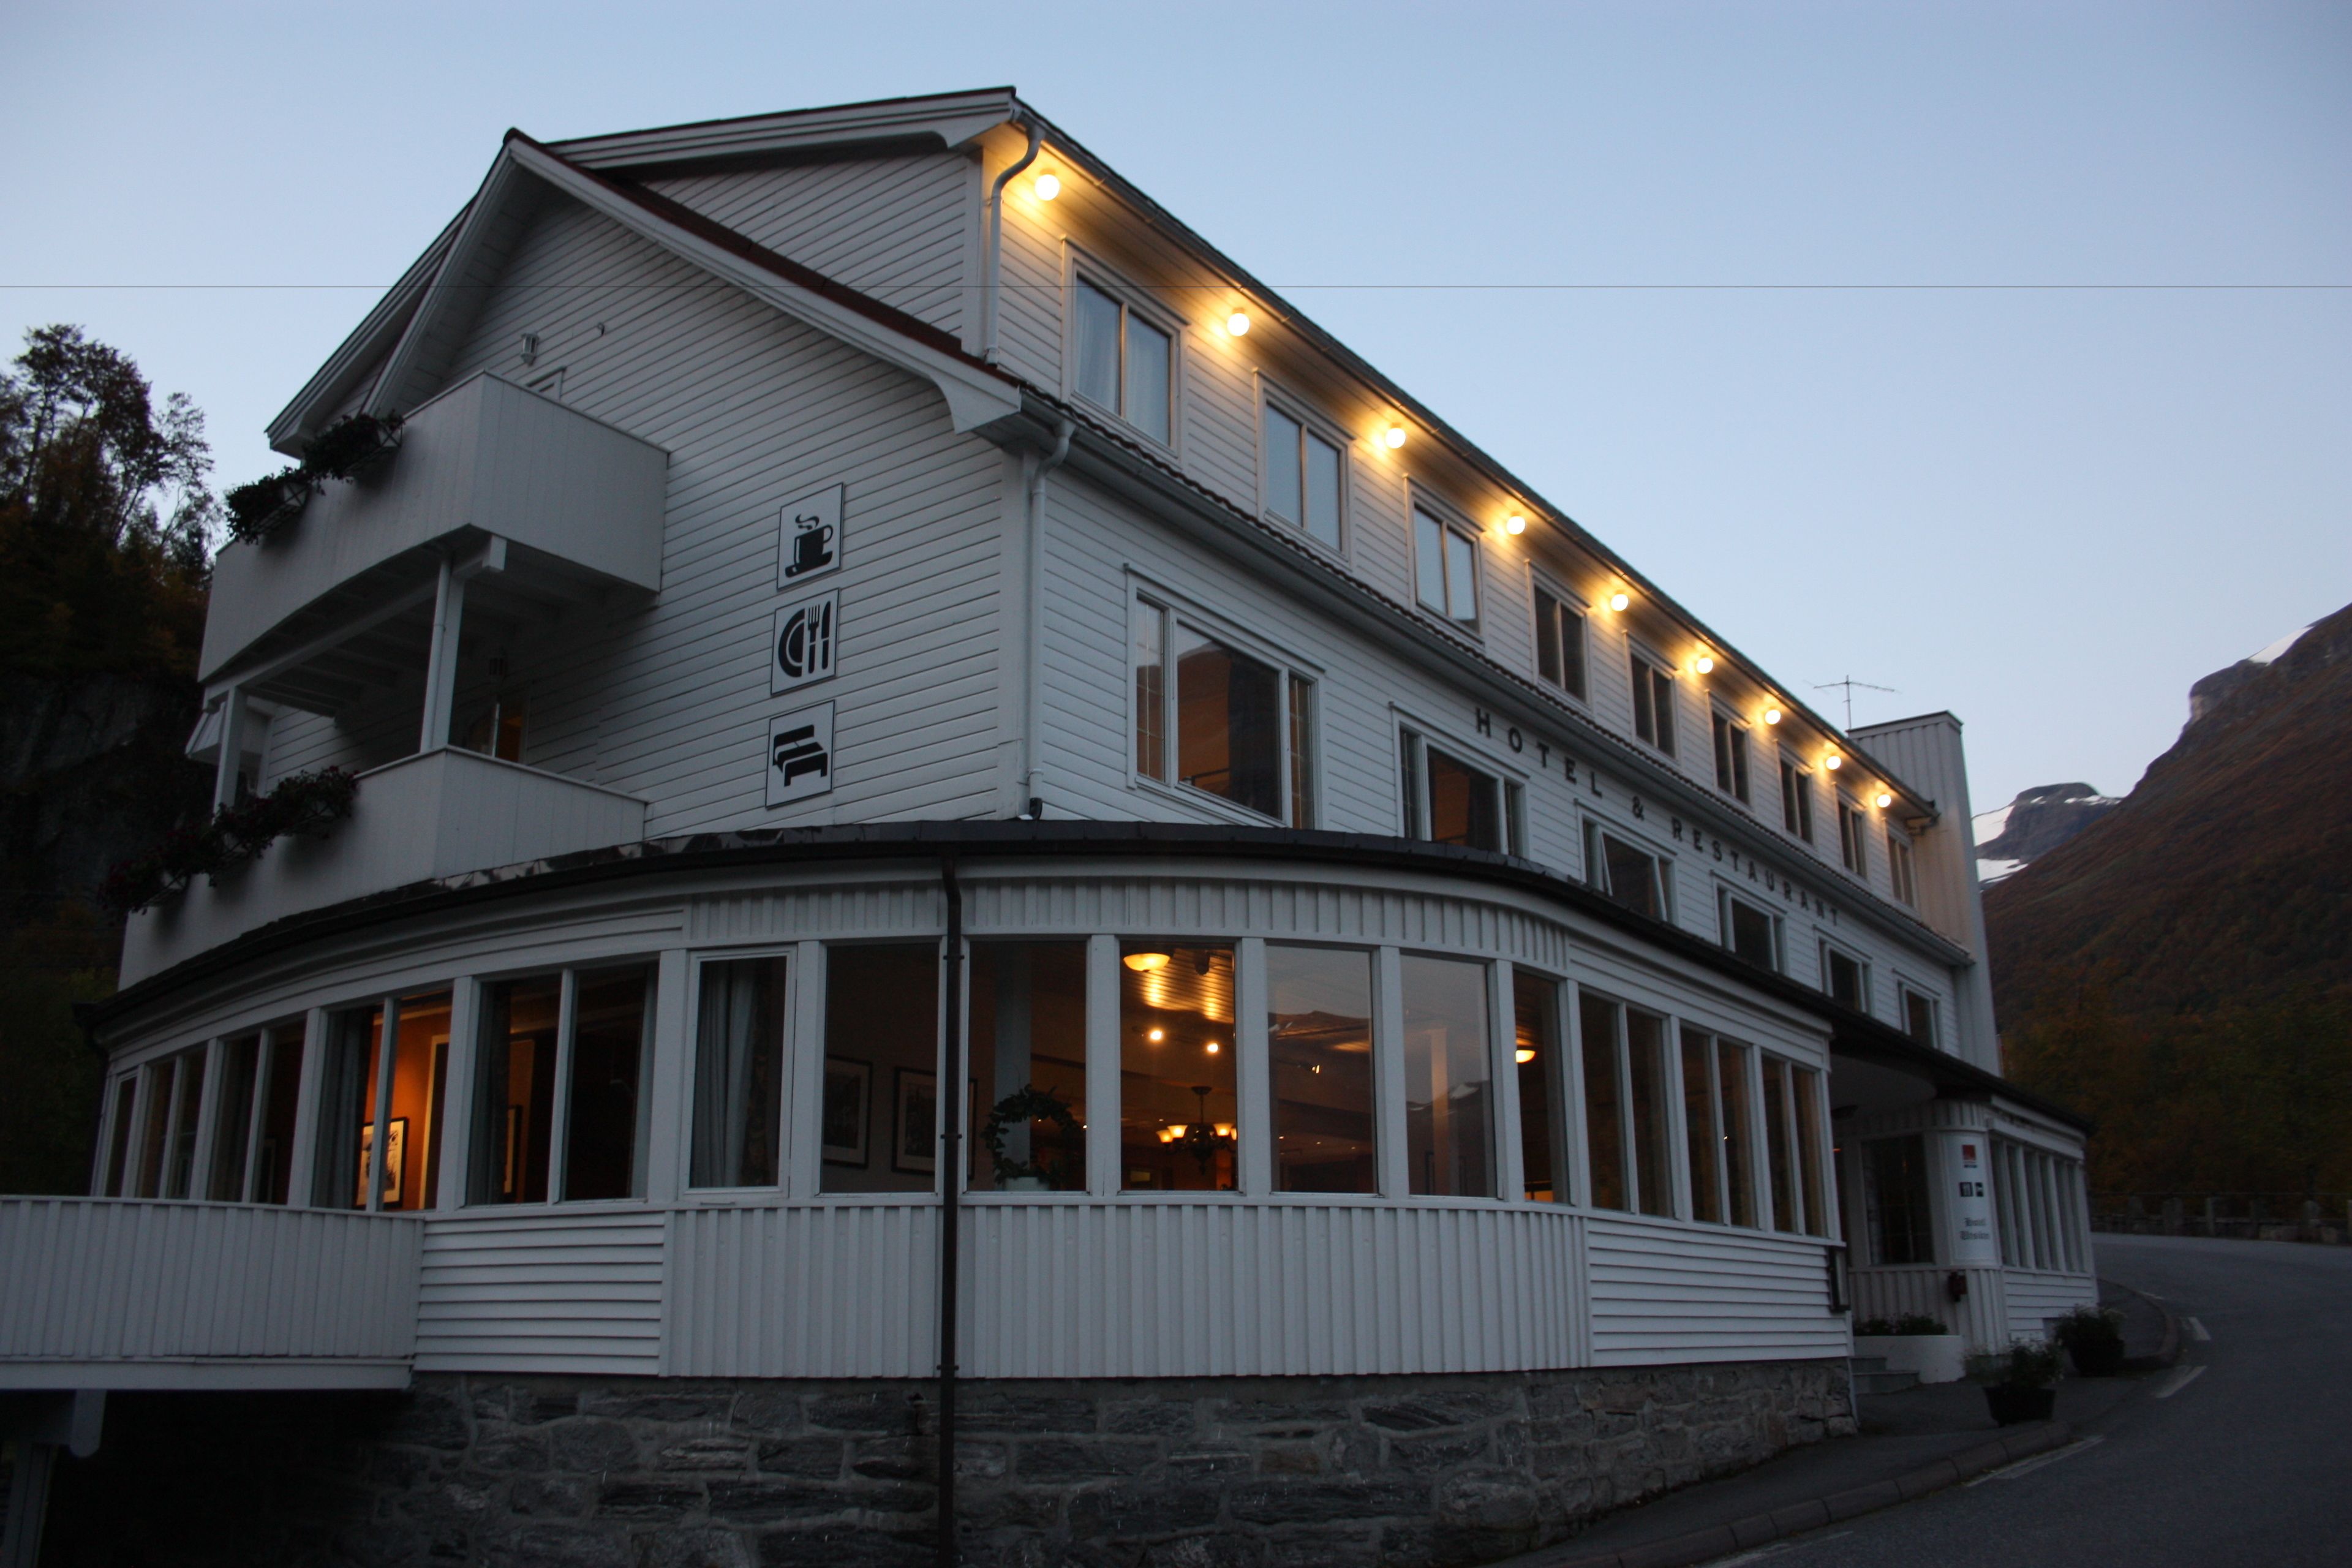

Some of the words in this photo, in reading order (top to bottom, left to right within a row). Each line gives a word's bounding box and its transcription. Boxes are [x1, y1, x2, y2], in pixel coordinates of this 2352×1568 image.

[1476, 707, 1602, 799] HOTEL
[1631, 796, 1645, 821] &
[1672, 816, 1838, 926] RESTAURANT
